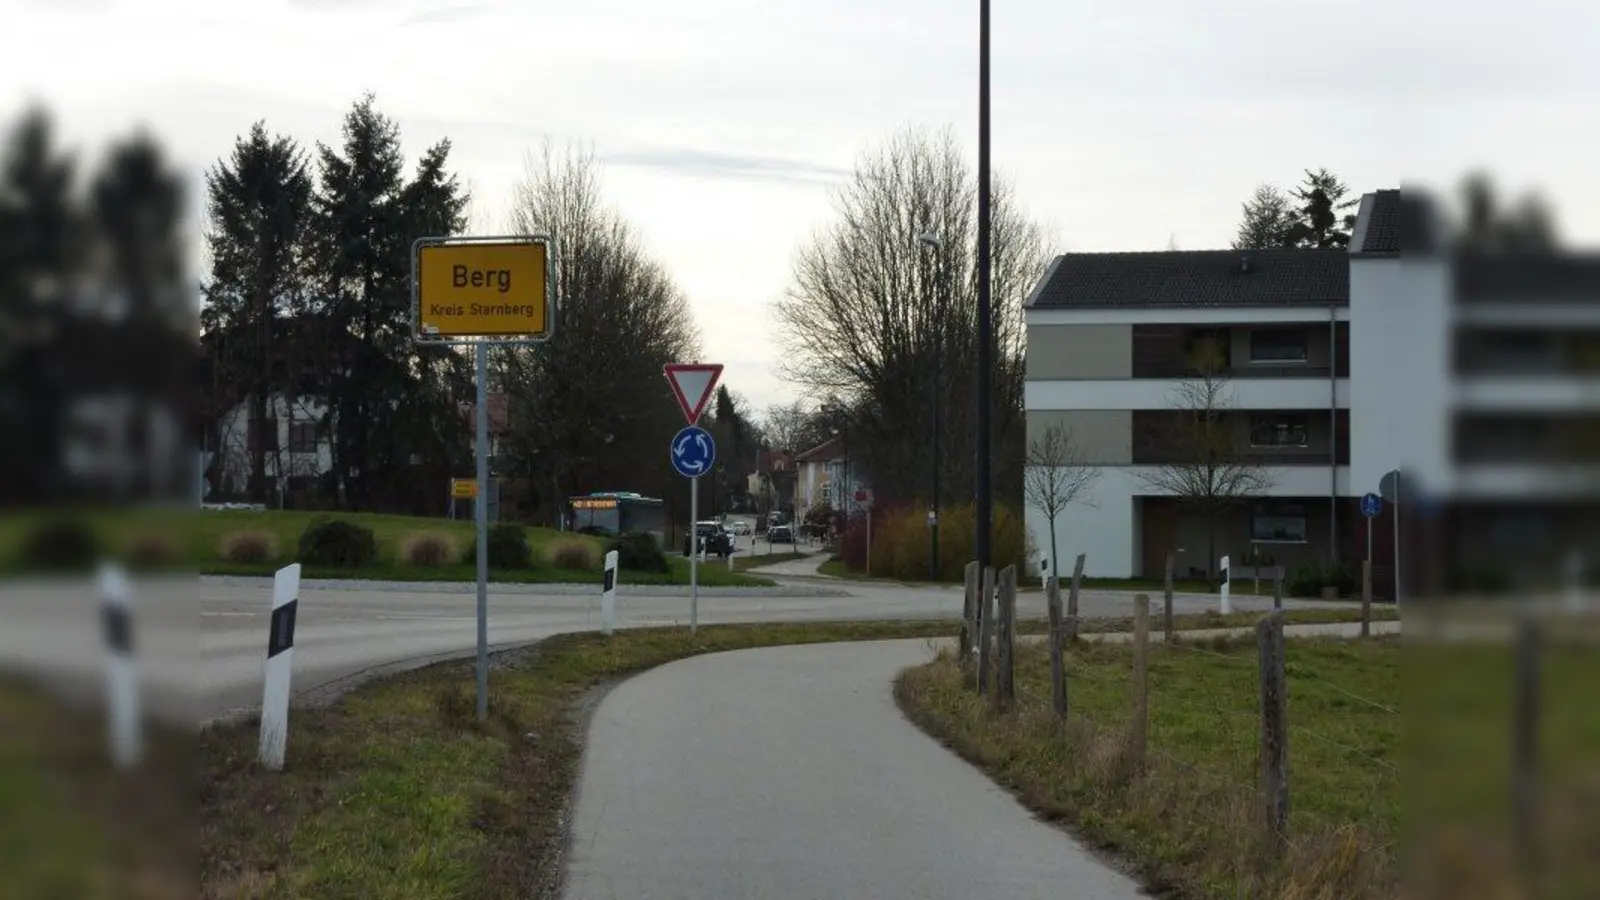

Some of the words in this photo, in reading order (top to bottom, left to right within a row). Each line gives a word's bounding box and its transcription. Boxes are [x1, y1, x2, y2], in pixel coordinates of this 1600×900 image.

[453, 265, 511, 292] Berg
[430, 303, 464, 316] Kreis
[470, 303, 534, 317] Starnberg
